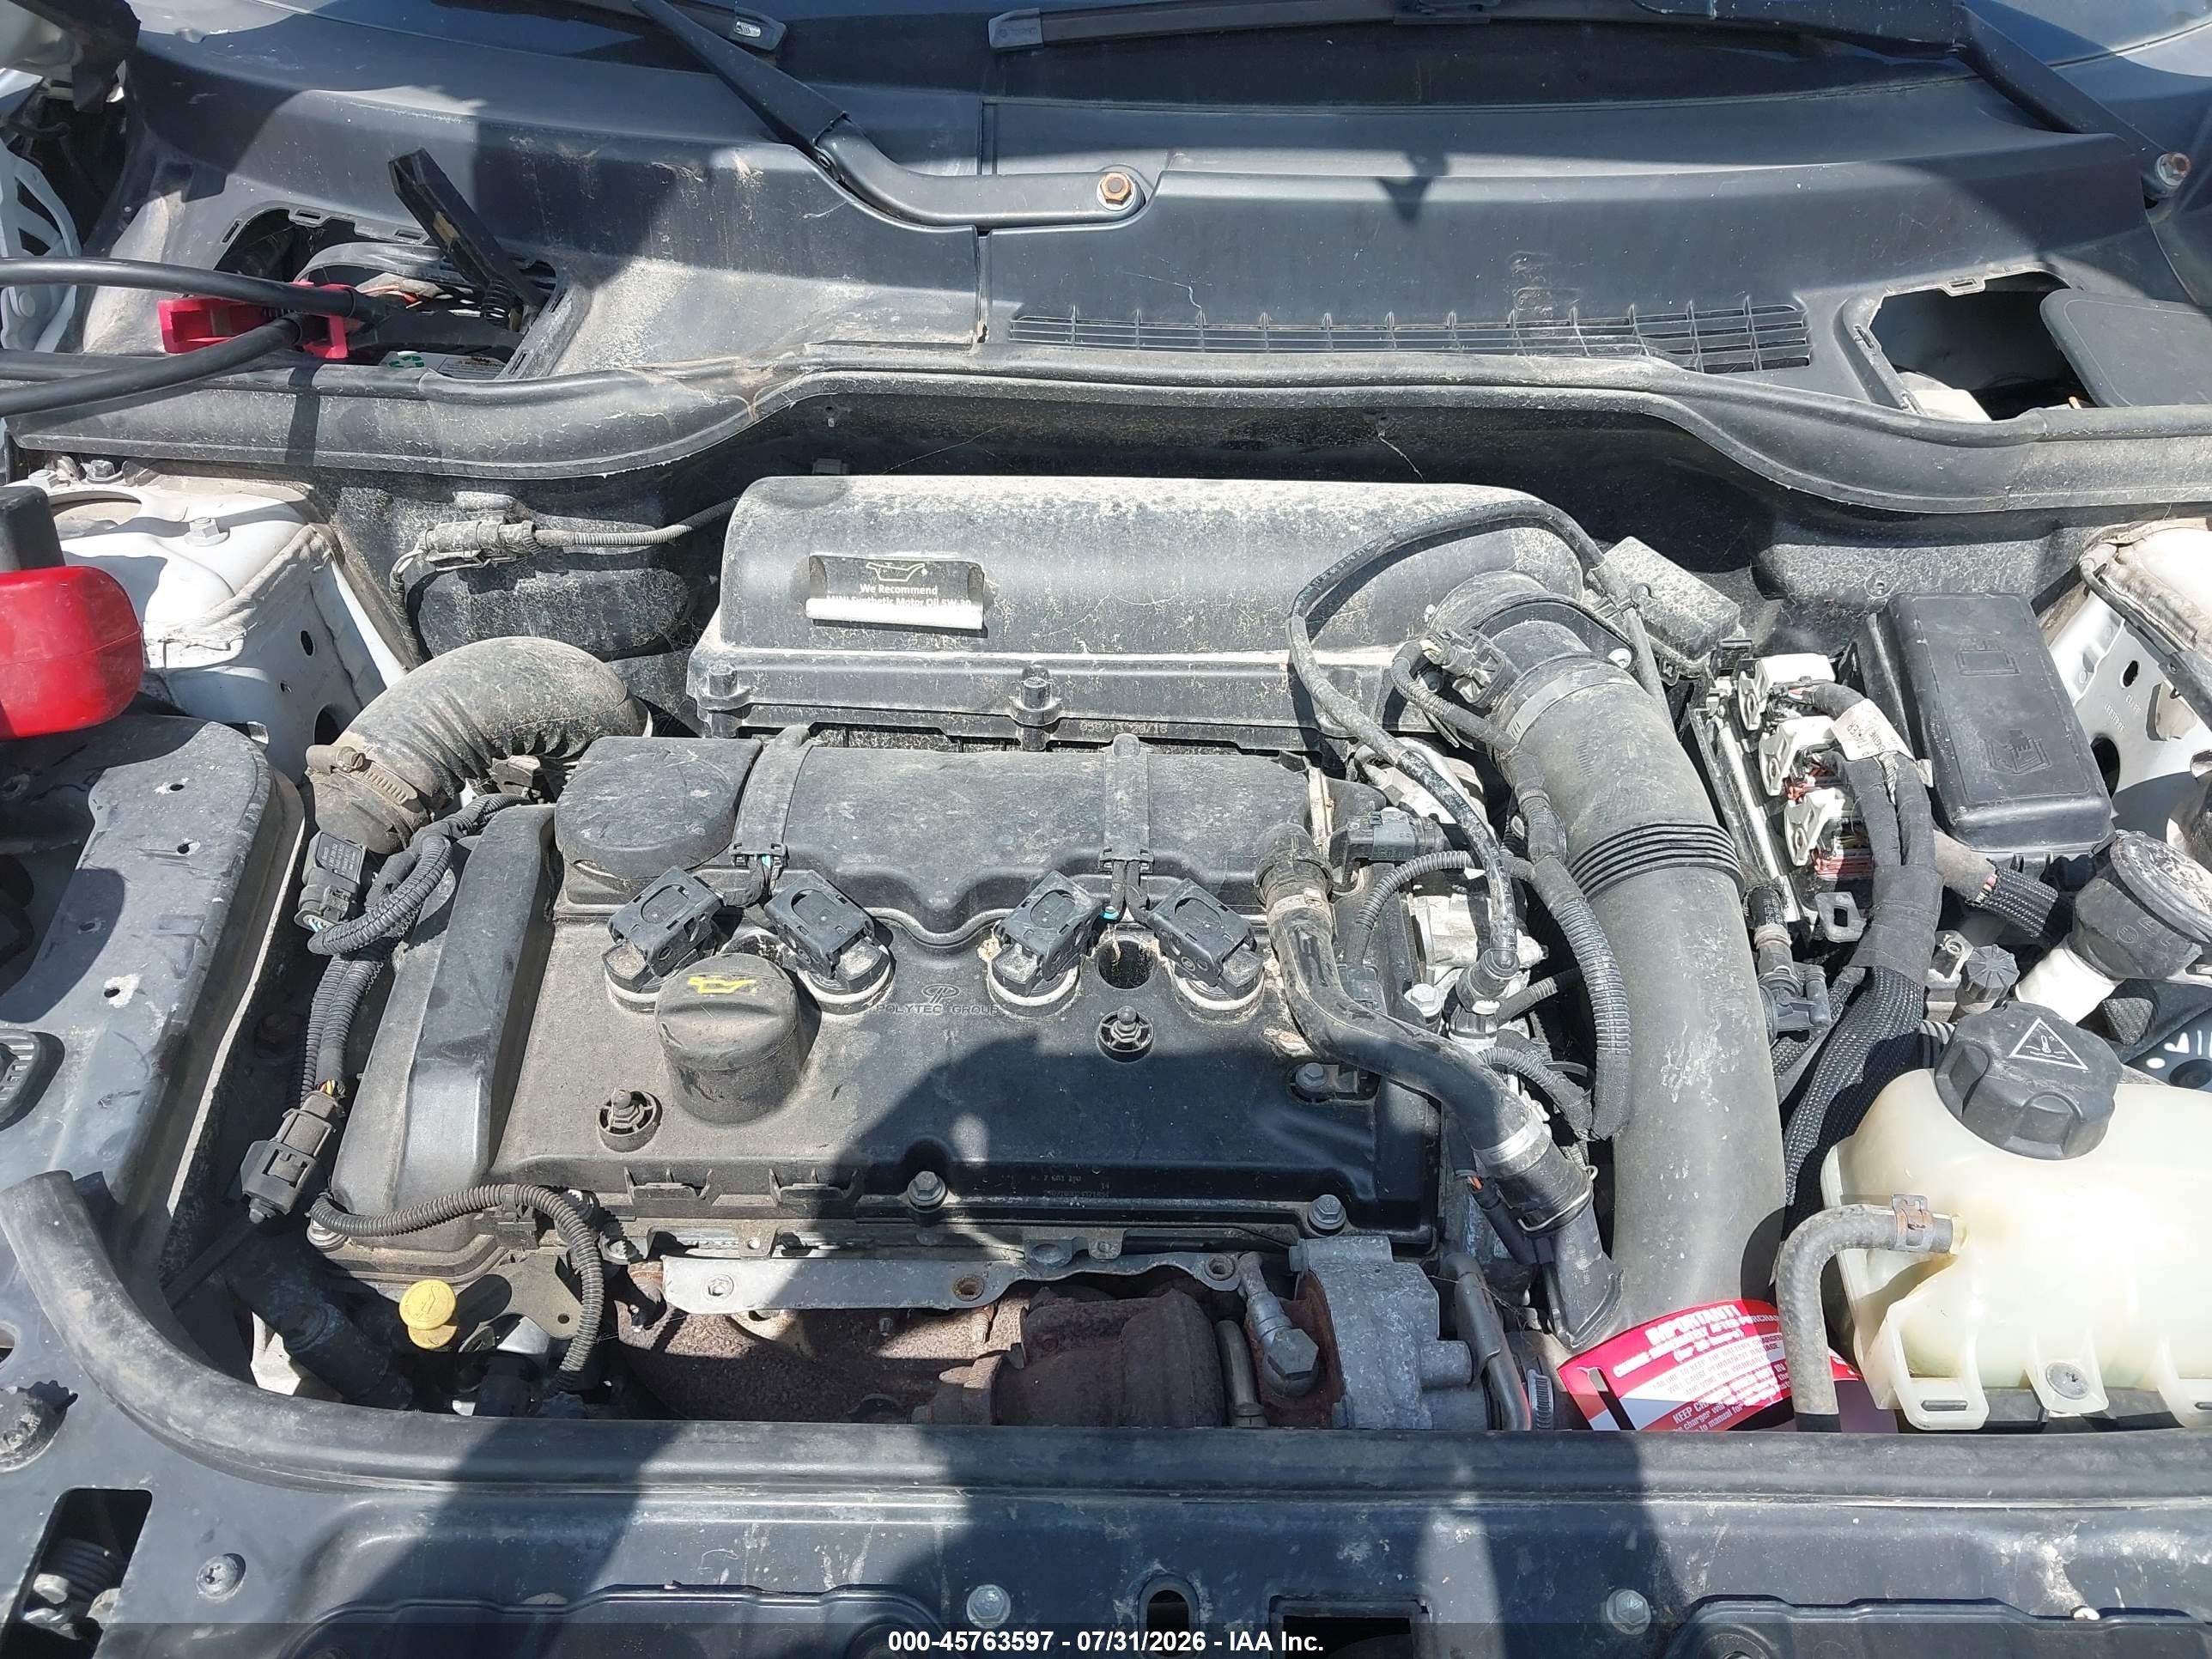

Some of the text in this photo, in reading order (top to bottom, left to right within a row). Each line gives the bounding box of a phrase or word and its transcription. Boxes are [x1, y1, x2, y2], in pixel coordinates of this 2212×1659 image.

[860, 583, 939, 595] We Recommend
[851, 596, 894, 605] Synthetic
[896, 597, 925, 606] Motor
[927, 598, 939, 607] Oil
[876, 1005, 1000, 1015] POLYTEC GROUP
[1644, 1305, 1741, 1346] IMPORTANT!
[1689, 1359, 1706, 1371] KEEP
[1708, 1353, 1720, 1362] THE
[1722, 1342, 1752, 1358] BATTERY
[1684, 1370, 1707, 1385] CAUSE
[1717, 1370, 1730, 1380] THE
[1672, 1407, 1693, 1425] KEEP
[1683, 1410, 1712, 1431] charger
[1707, 1409, 1733, 1428] manual
[1732, 1402, 1743, 1414] for
